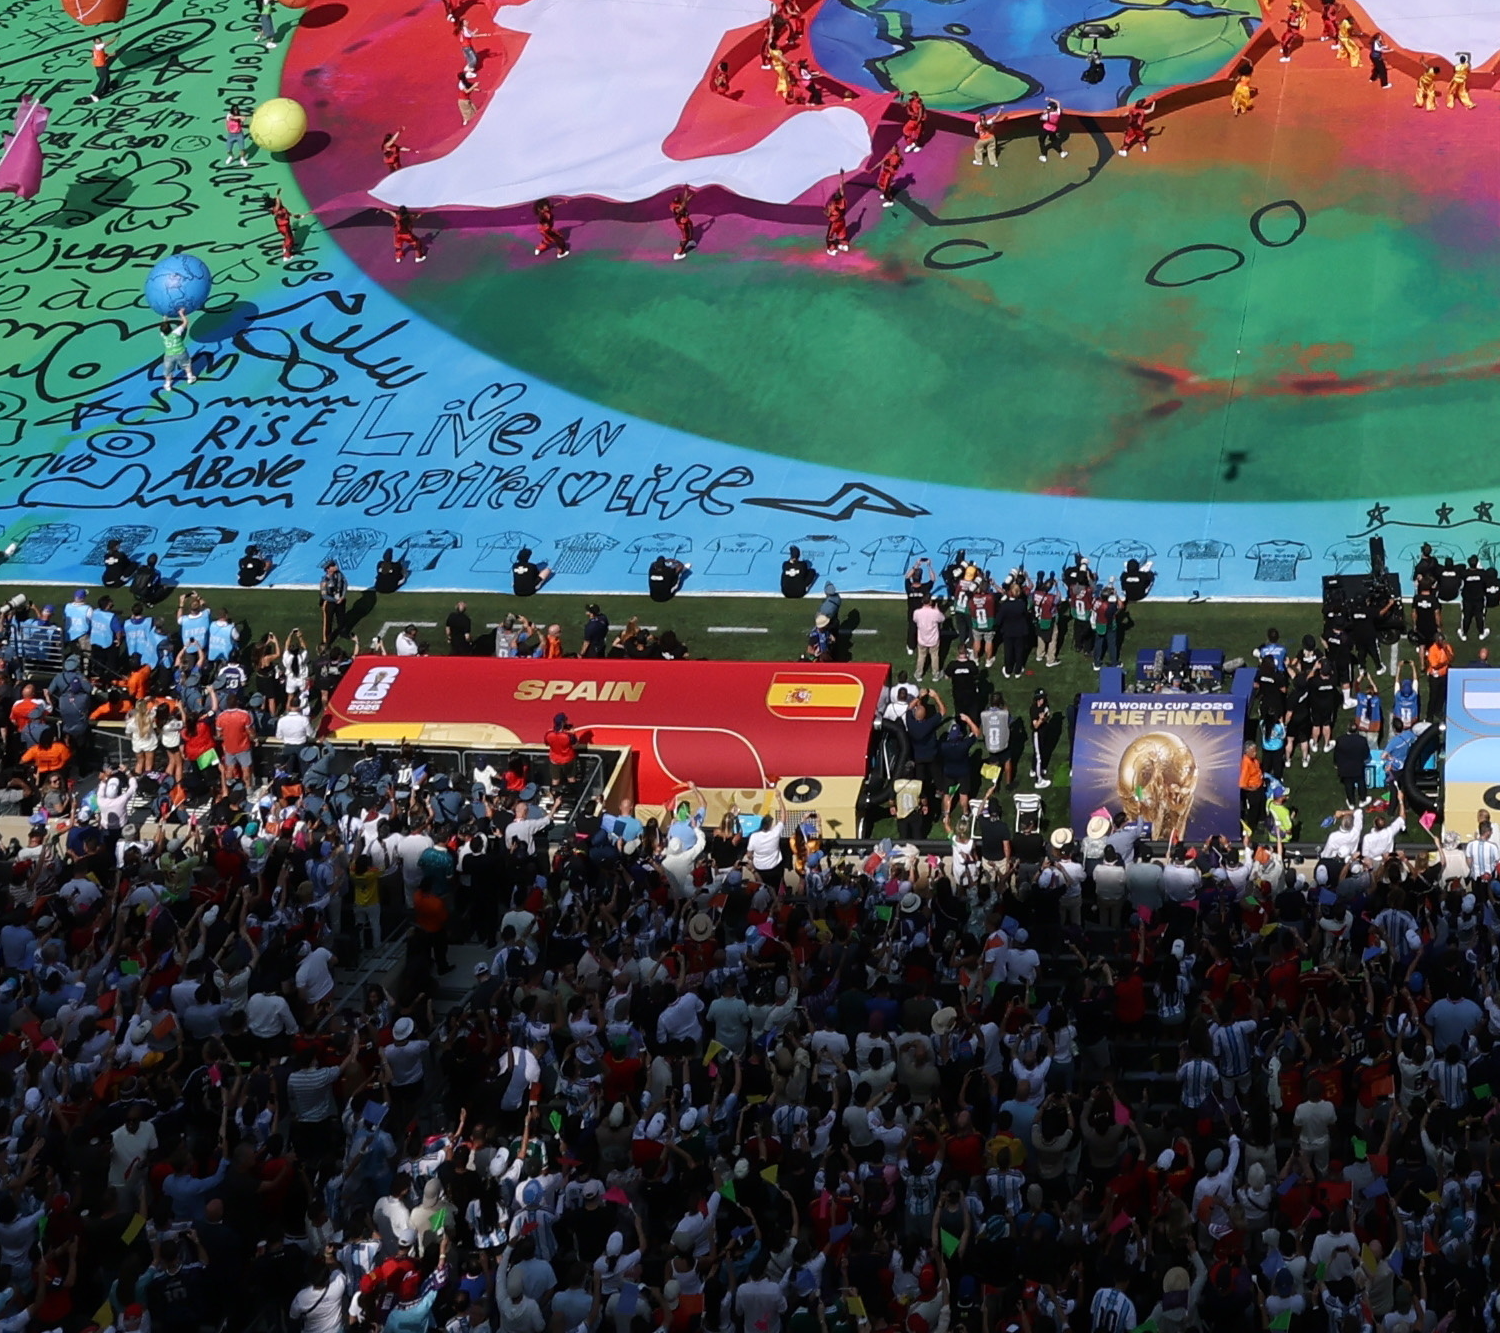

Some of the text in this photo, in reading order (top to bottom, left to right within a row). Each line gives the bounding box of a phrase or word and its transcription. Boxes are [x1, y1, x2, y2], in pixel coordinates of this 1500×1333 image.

[52, 107, 201, 128] DREAM
[514, 679, 646, 702] SPAIN
[1091, 702, 1234, 710] FIFA WORLD CUP 2026
[1090, 710, 1232, 726] THE FINAL
